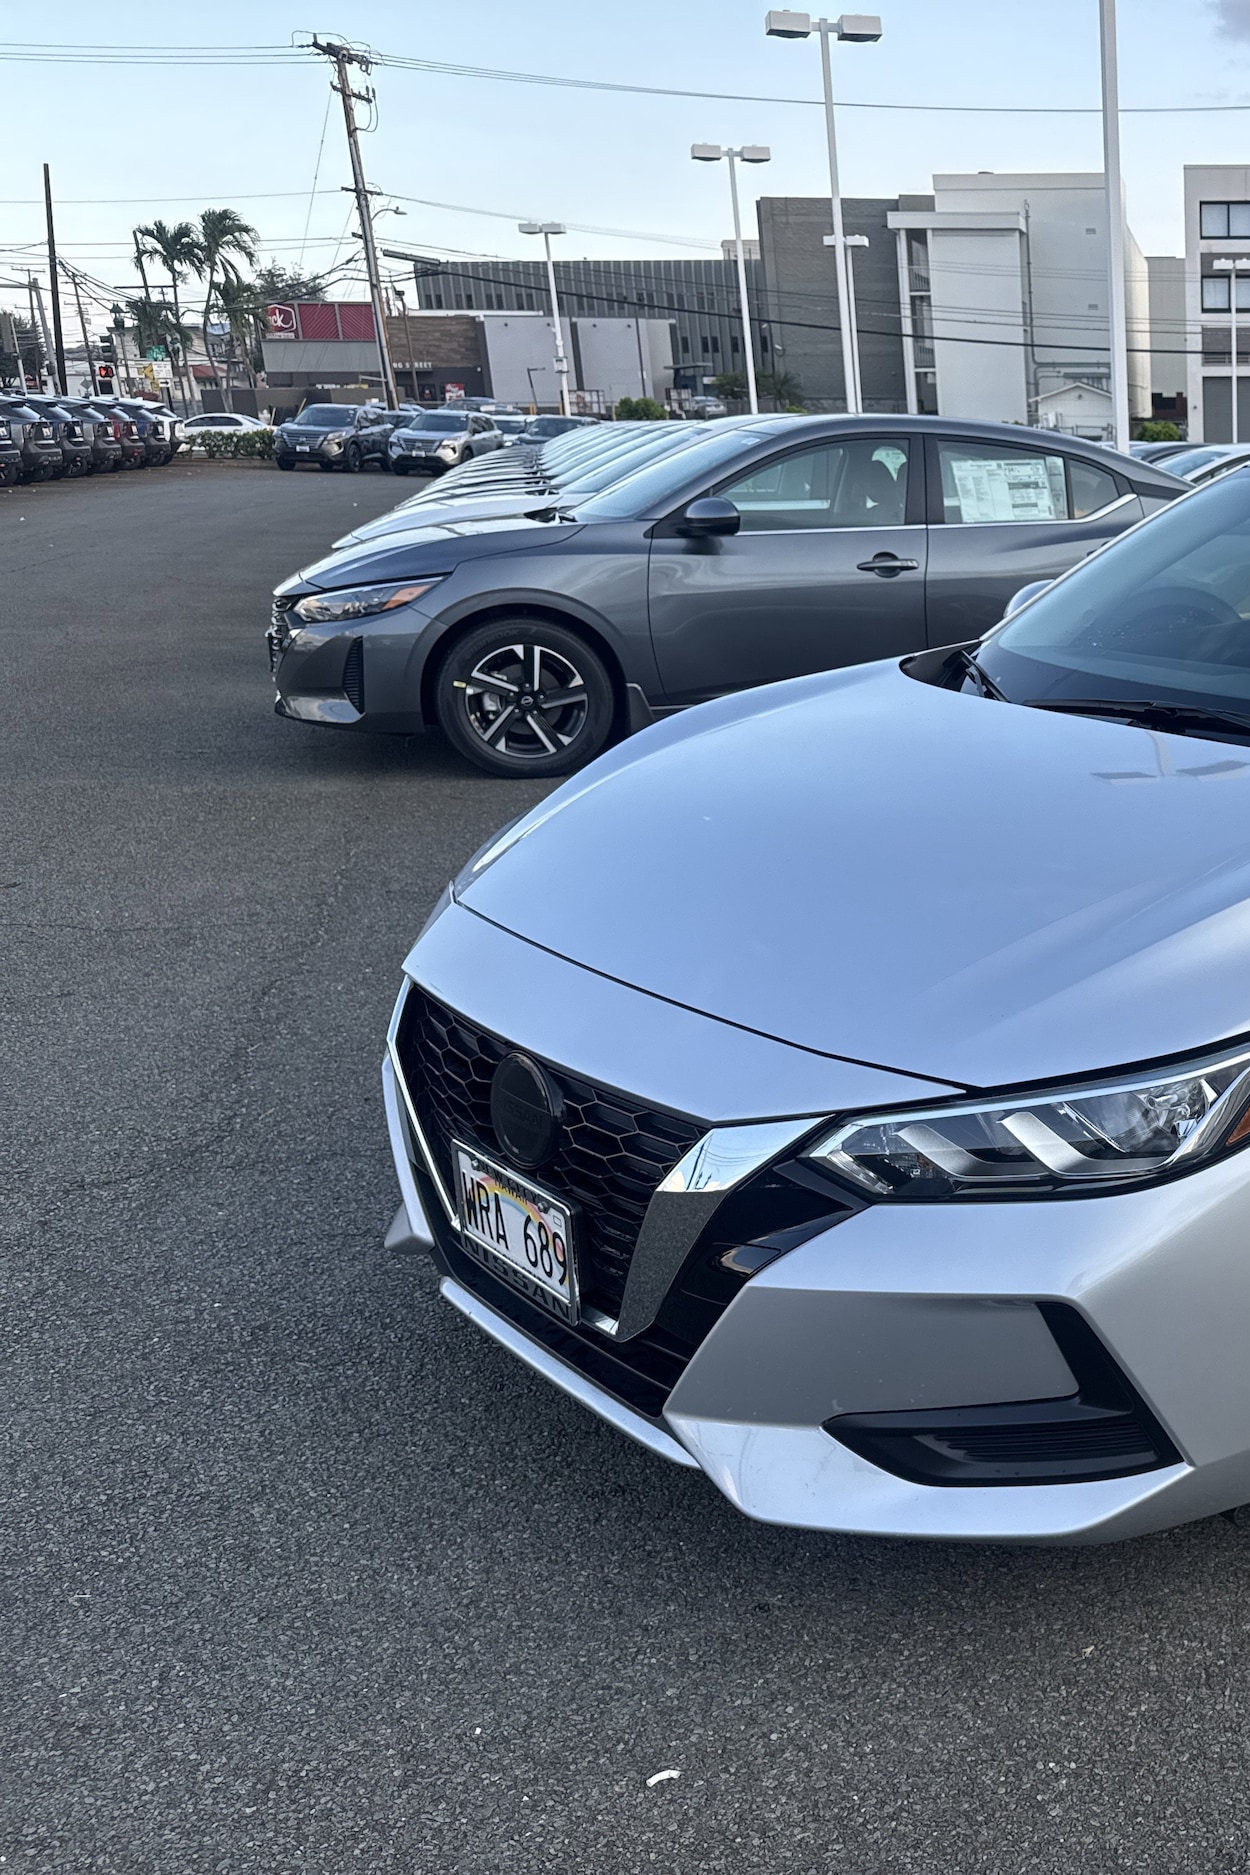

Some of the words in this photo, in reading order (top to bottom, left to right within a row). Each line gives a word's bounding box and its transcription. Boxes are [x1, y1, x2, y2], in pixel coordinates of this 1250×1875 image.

[461, 1169, 510, 1251] WRA
[524, 1214, 567, 1286] 689
[464, 1234, 571, 1321] NISSAN
